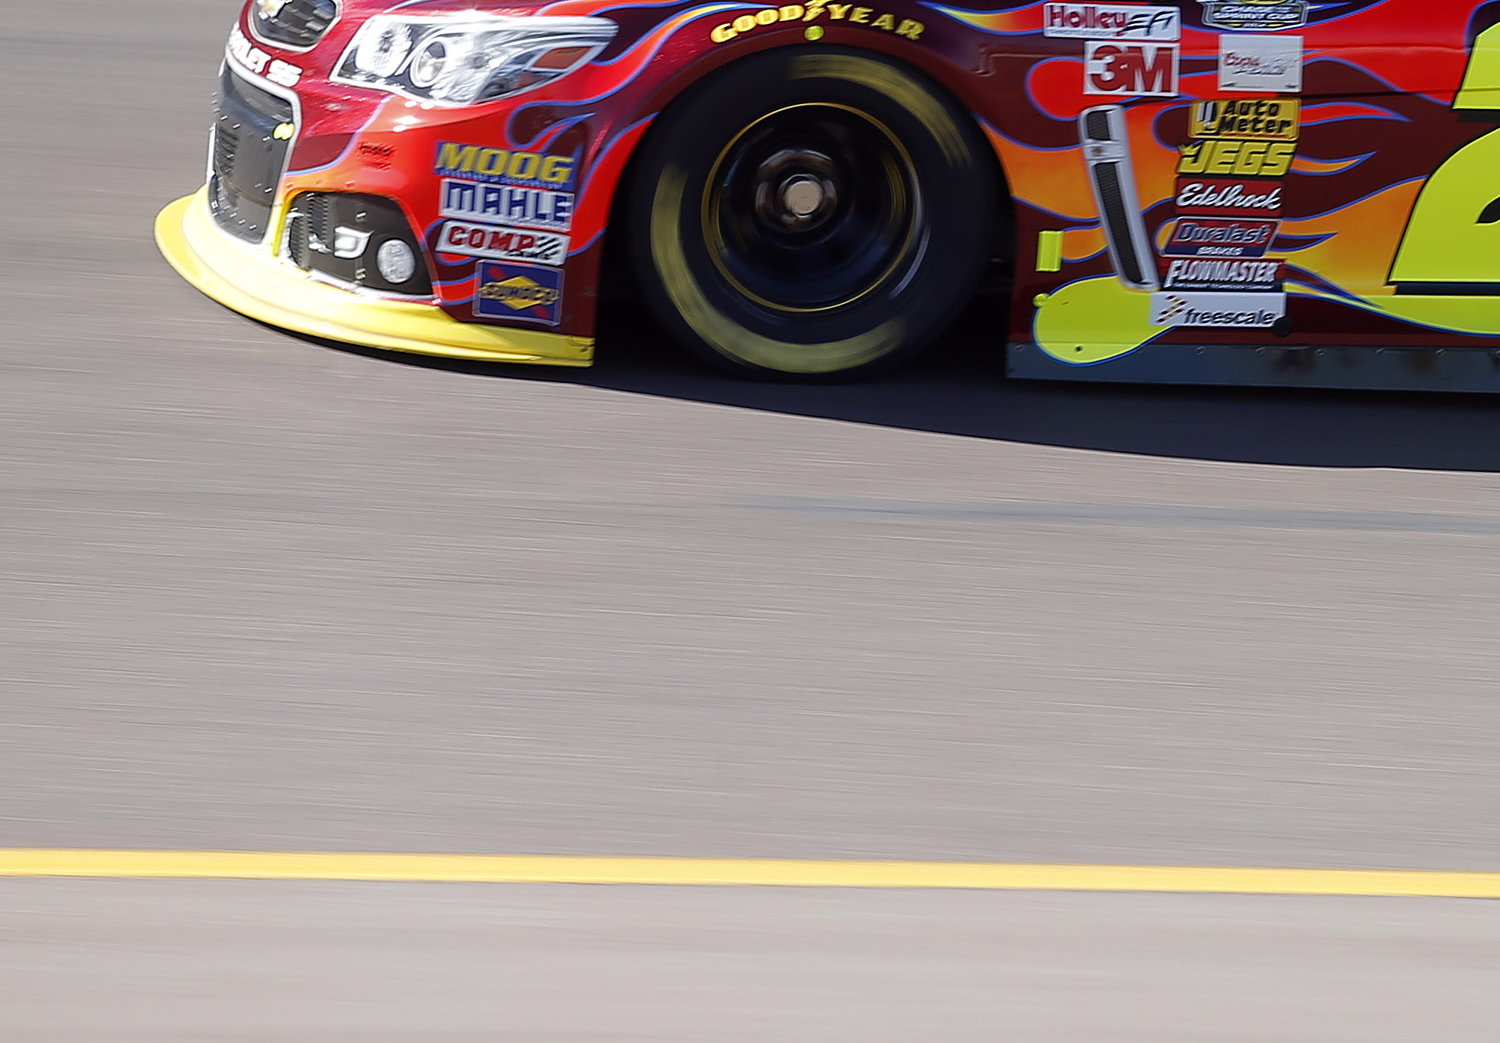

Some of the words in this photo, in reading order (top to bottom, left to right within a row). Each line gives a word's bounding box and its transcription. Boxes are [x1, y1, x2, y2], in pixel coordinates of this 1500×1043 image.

[1046, 5, 1129, 36] Holley
[1090, 45, 1173, 91] 3M
[1222, 99, 1280, 116] Auto
[1217, 115, 1292, 133] Meter
[435, 142, 576, 183] MOOG
[1177, 141, 1298, 175] JEGS
[442, 180, 572, 224] MAHLE
[1176, 182, 1282, 210] Edelbrock
[448, 226, 537, 252] COMP
[1173, 222, 1272, 244] Duralast
[1164, 260, 1280, 288] FLOWMASTER
[1184, 307, 1277, 326] freescale
